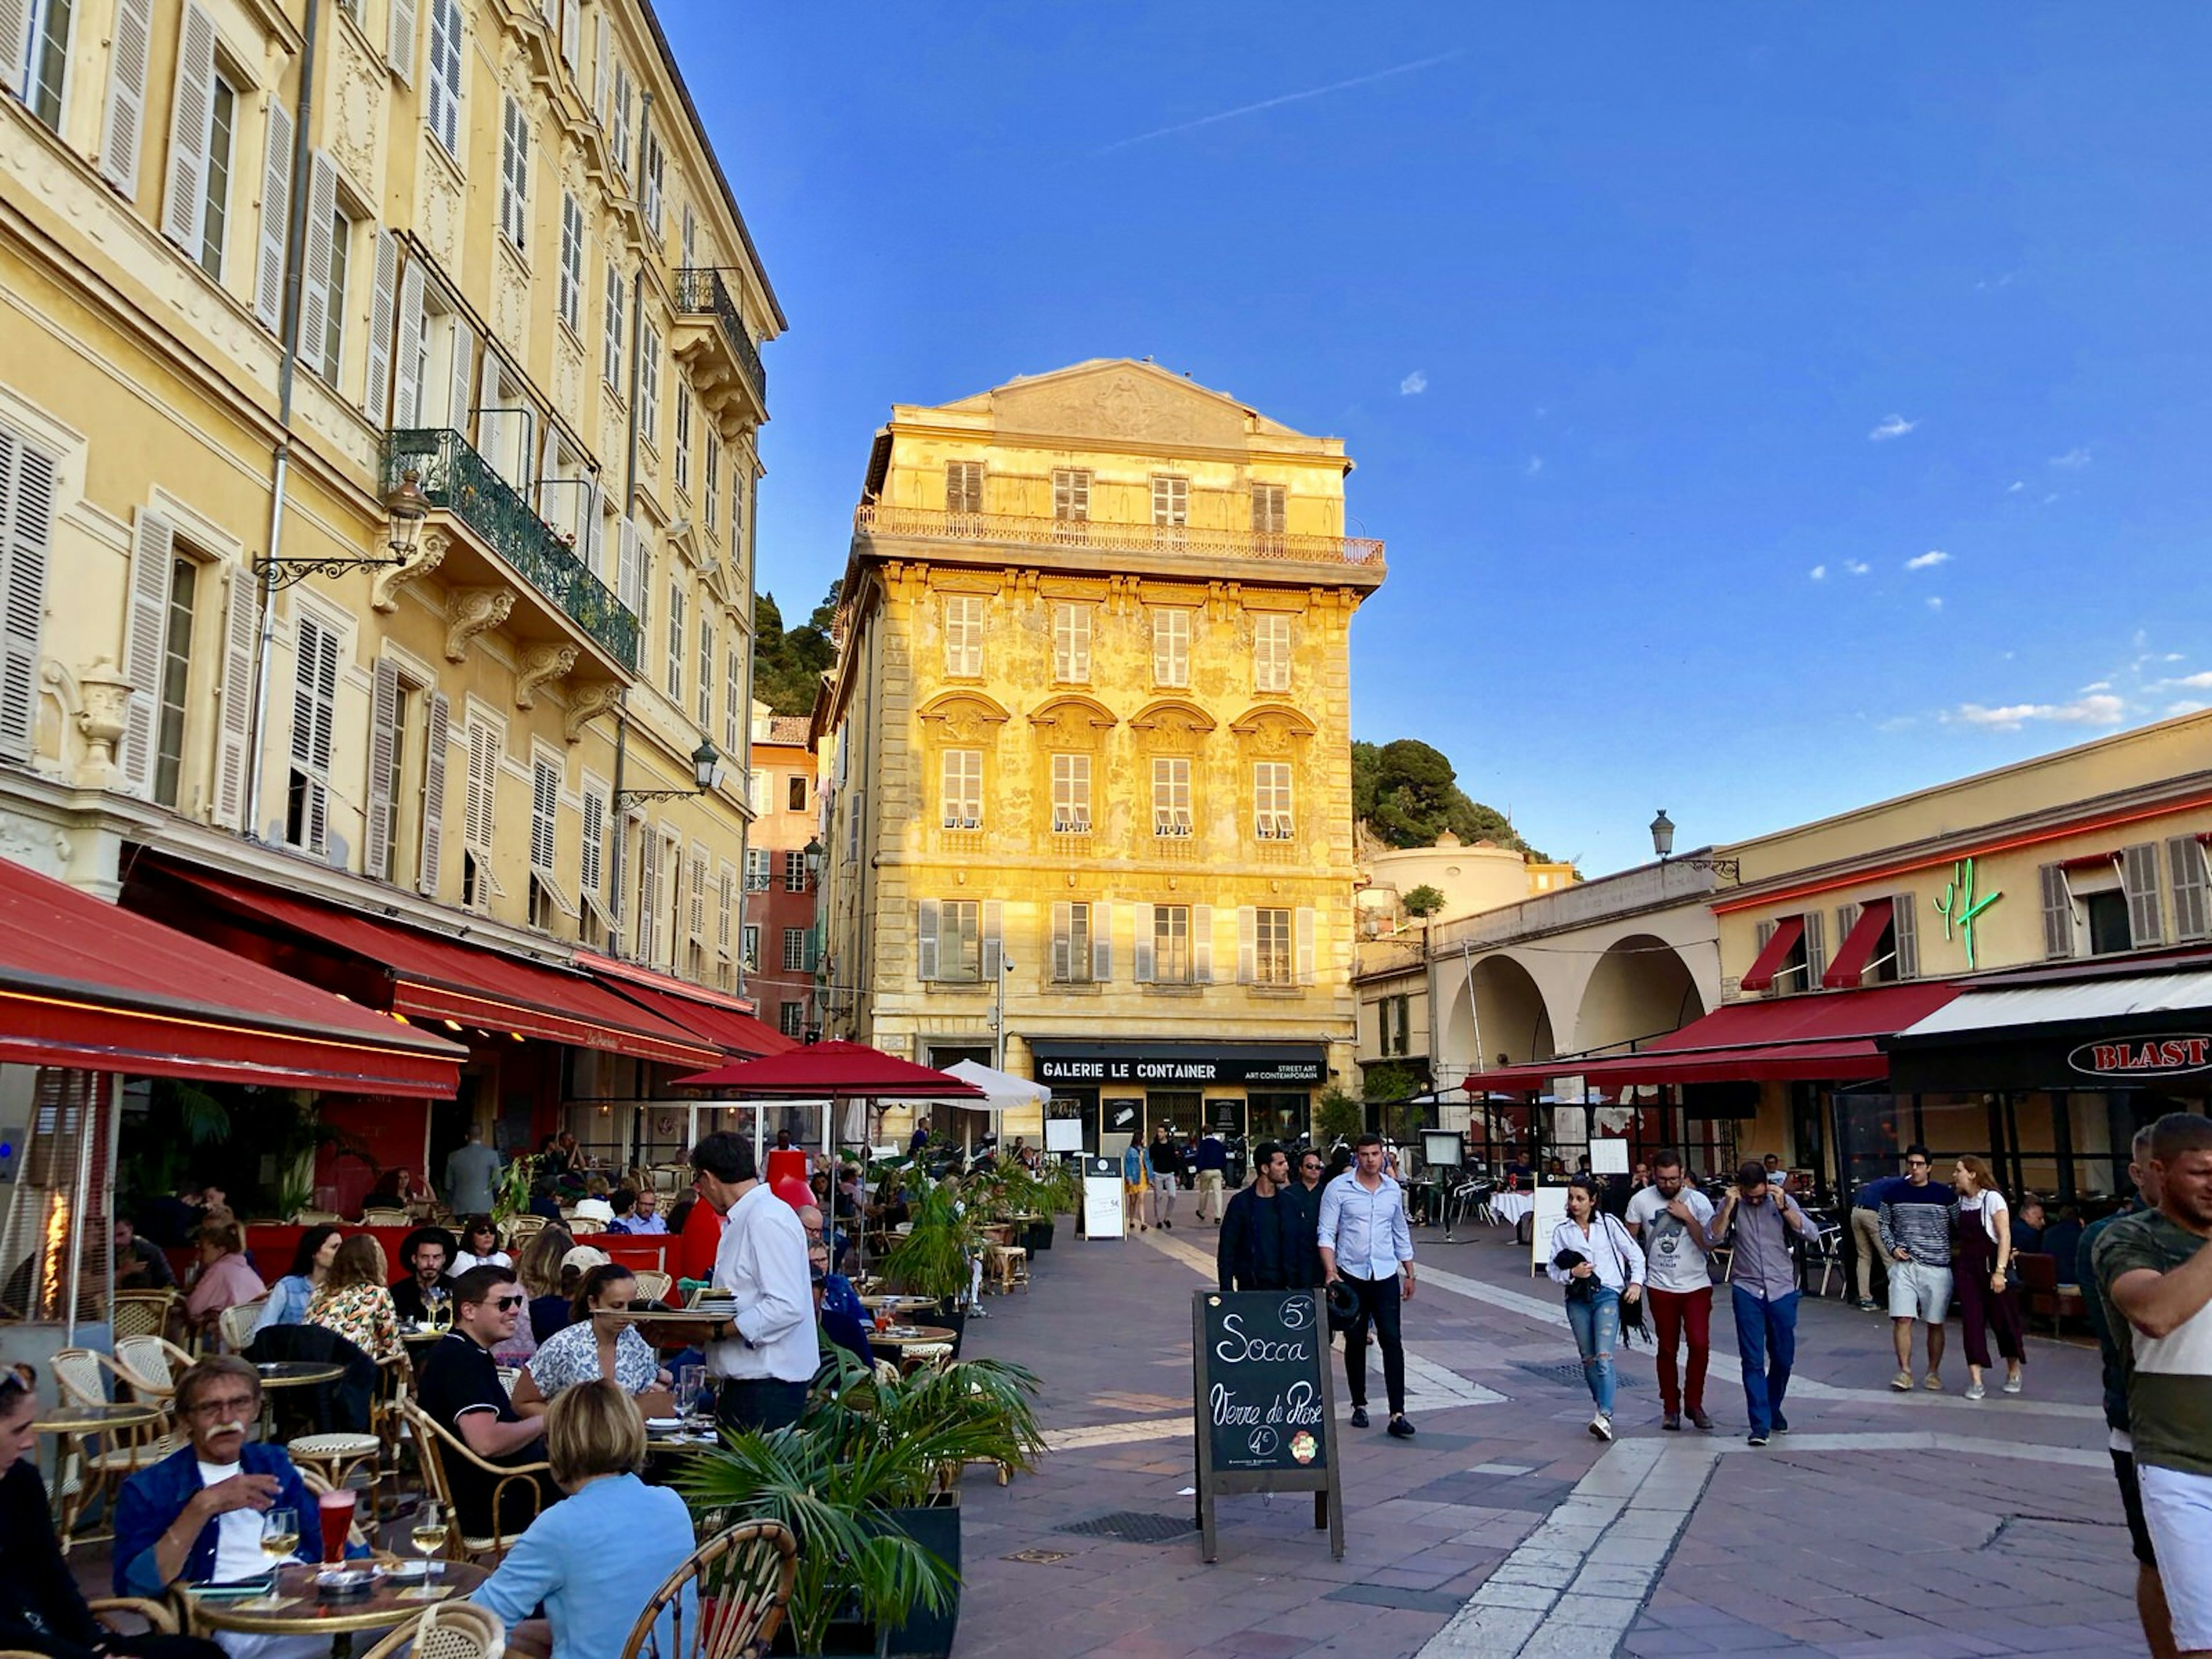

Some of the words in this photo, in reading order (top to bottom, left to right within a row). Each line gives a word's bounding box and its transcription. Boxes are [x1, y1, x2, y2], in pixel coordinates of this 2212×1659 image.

[1043, 1062, 1104, 1077] GALERIE
[1111, 1063, 1130, 1078] LE
[1137, 1064, 1216, 1079] CONTAINER
[2092, 1037, 2209, 1070] BLAST
[1216, 1313, 1310, 1363] Socca
[1210, 1382, 1260, 1426] Verre
[1266, 1394, 1283, 1424] de
[1286, 1380, 1322, 1425] Rosé
